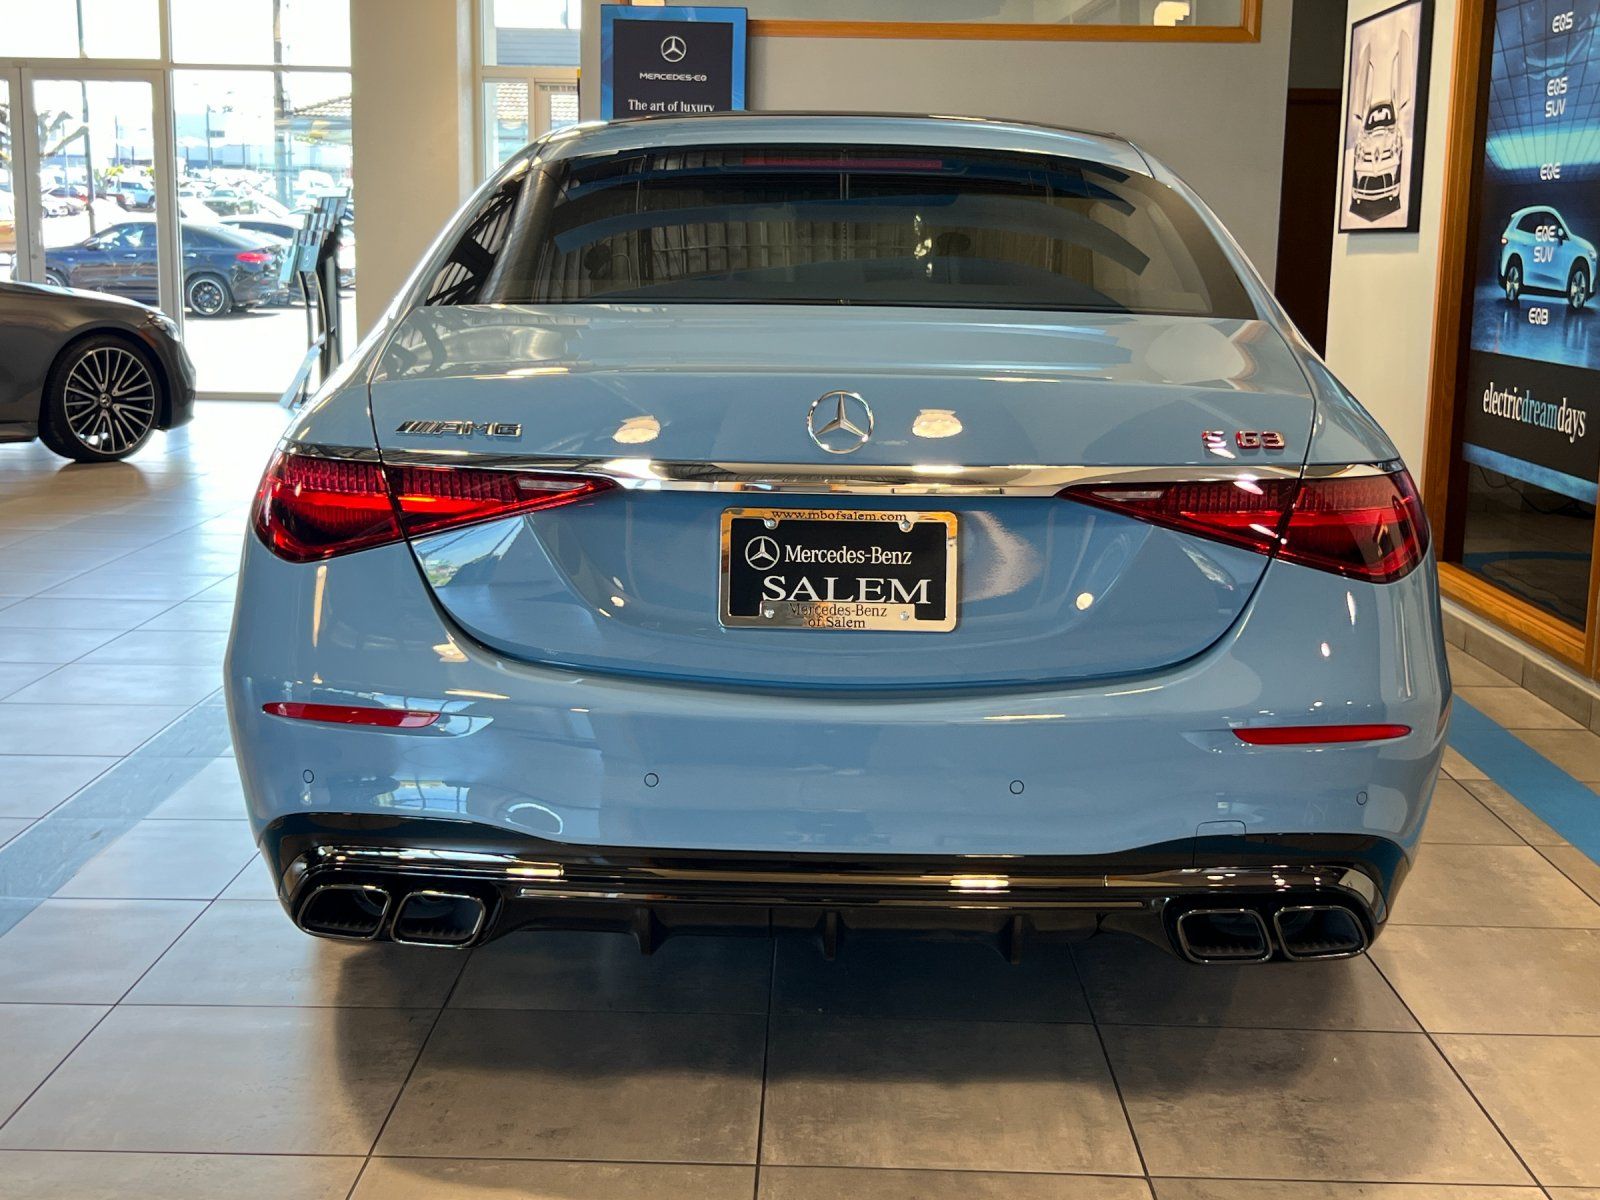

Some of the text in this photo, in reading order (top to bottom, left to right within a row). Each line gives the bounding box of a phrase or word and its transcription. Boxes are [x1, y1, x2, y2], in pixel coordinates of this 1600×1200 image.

[1552, 11, 1574, 33] EQS
[639, 72, 708, 82] MERCEDES-EQ
[1547, 76, 1568, 97] EQS
[628, 99, 715, 113] The art of luxury
[1545, 99, 1566, 118] SUV
[1540, 162, 1561, 180] EQE
[1535, 225, 1556, 243] EQE
[1533, 246, 1554, 263] SUV
[1528, 307, 1549, 325] EQB
[437, 421, 522, 437] AMG
[1236, 431, 1285, 449] 63
[771, 510, 907, 522] www.mbofsalem.com
[785, 545, 912, 565] Mercedes-Benz
[762, 575, 932, 604] SALEM
[789, 602, 888, 617] Mercedes-Benz
[808, 616, 866, 628] of Salem
